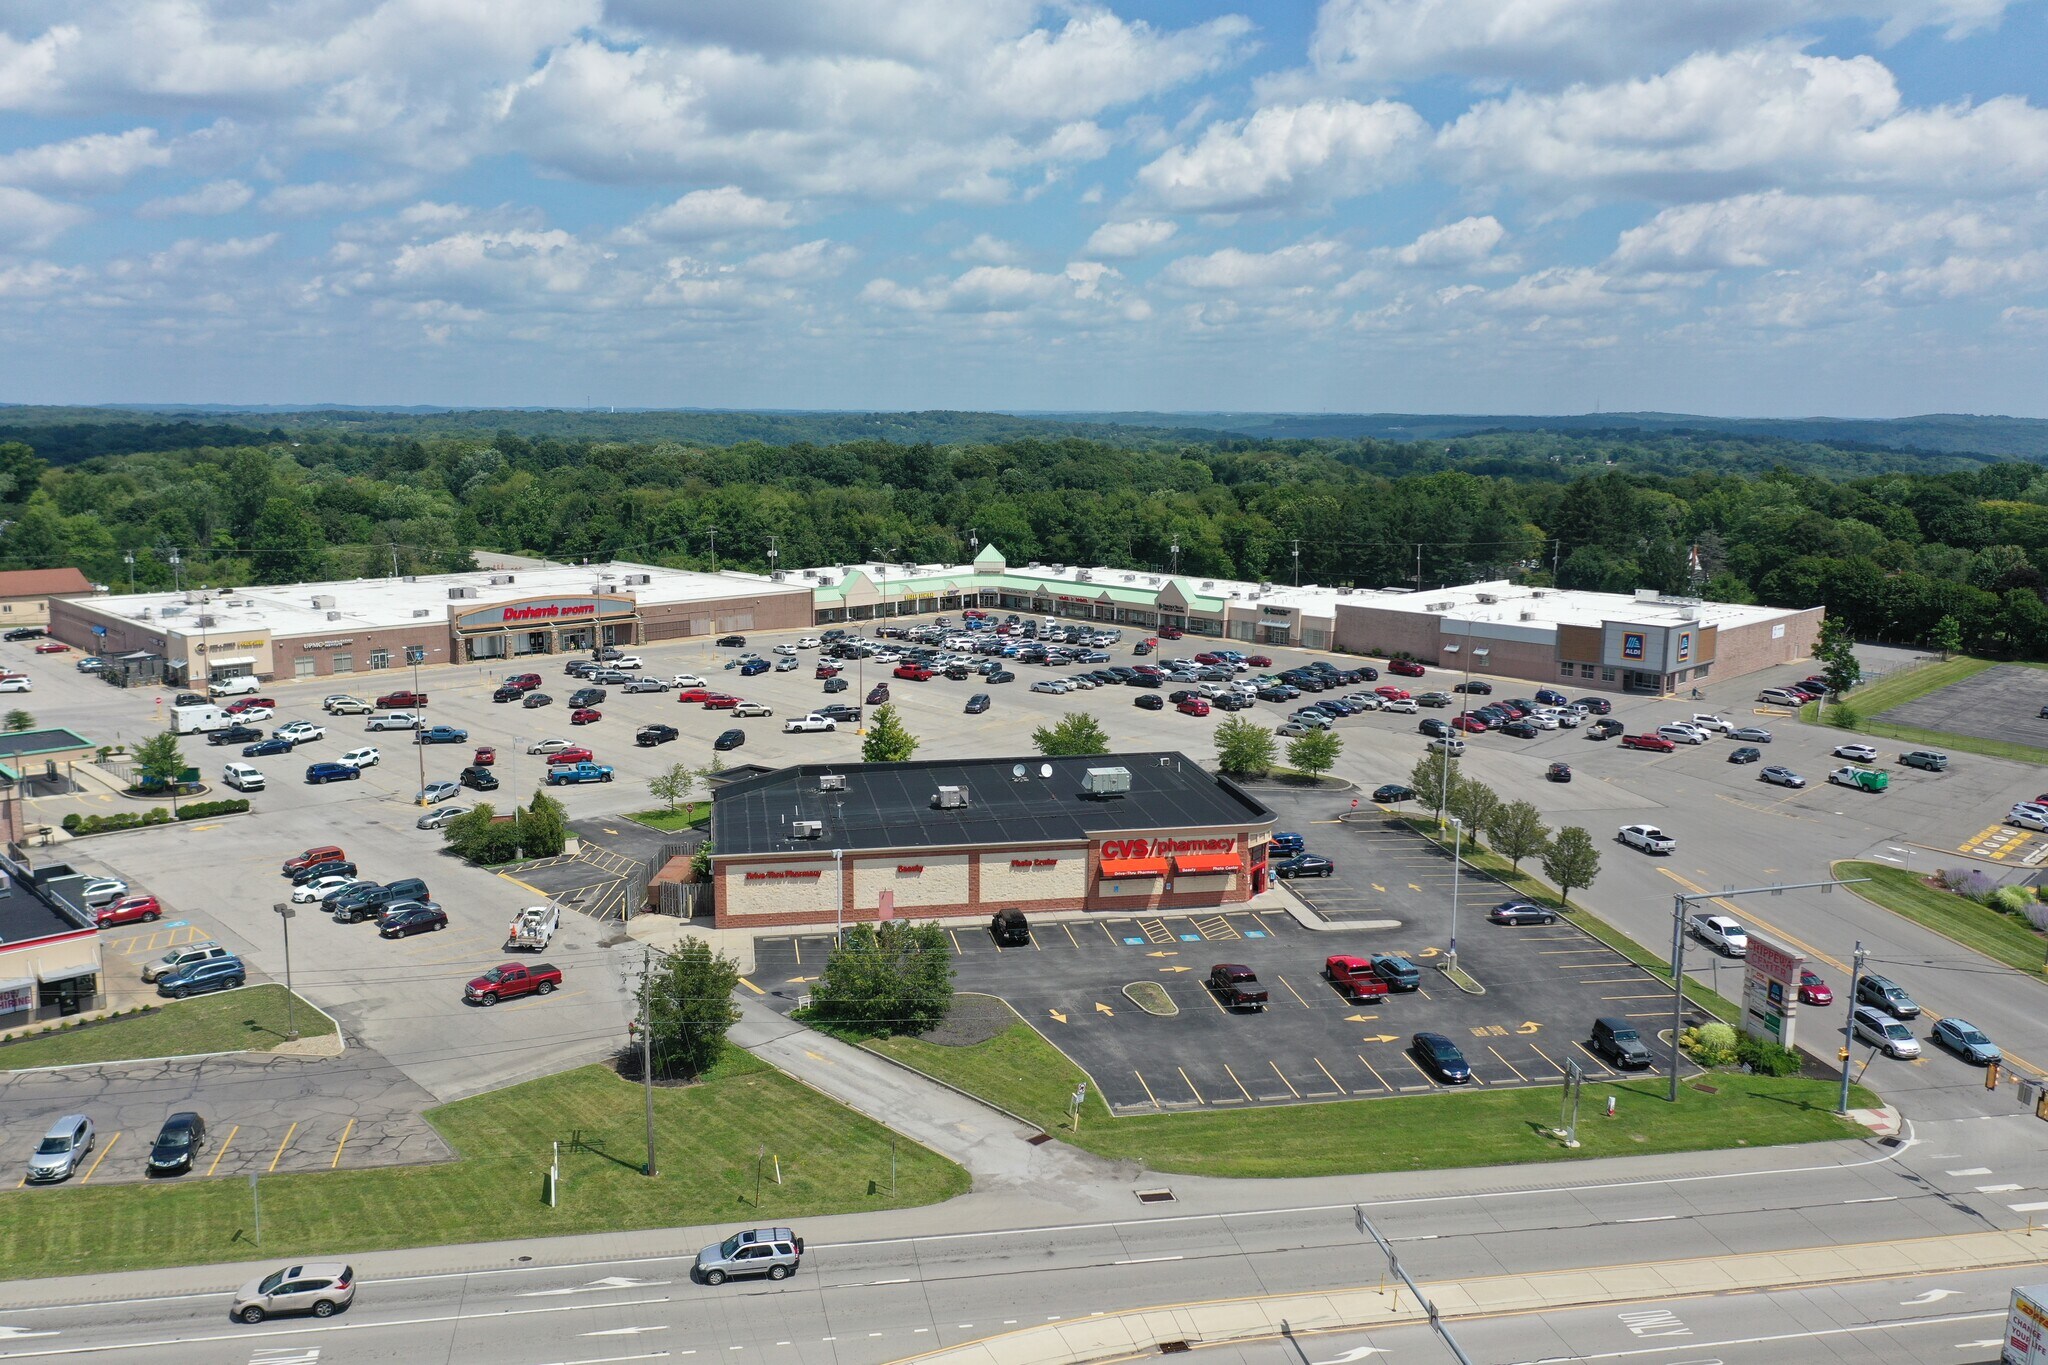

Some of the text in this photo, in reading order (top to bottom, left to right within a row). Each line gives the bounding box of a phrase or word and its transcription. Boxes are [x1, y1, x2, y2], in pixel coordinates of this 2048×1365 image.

[503, 604, 594, 620] Dunham's SPORTS
[303, 642, 323, 650] UPMC
[897, 865, 924, 873] Beauty
[1011, 858, 1058, 867] Photo Center
[746, 870, 822, 880] Drive-Thru Pharmacy
[1746, 939, 1793, 970] CHIPPEWA
[1751, 953, 1786, 977] CENTER
[1618, 1309, 1693, 1338] ONLY
[2013, 1316, 2042, 1341] CHANGE
[247, 1346, 322, 1365] NLY
[2031, 1341, 2047, 1356] LIFE
